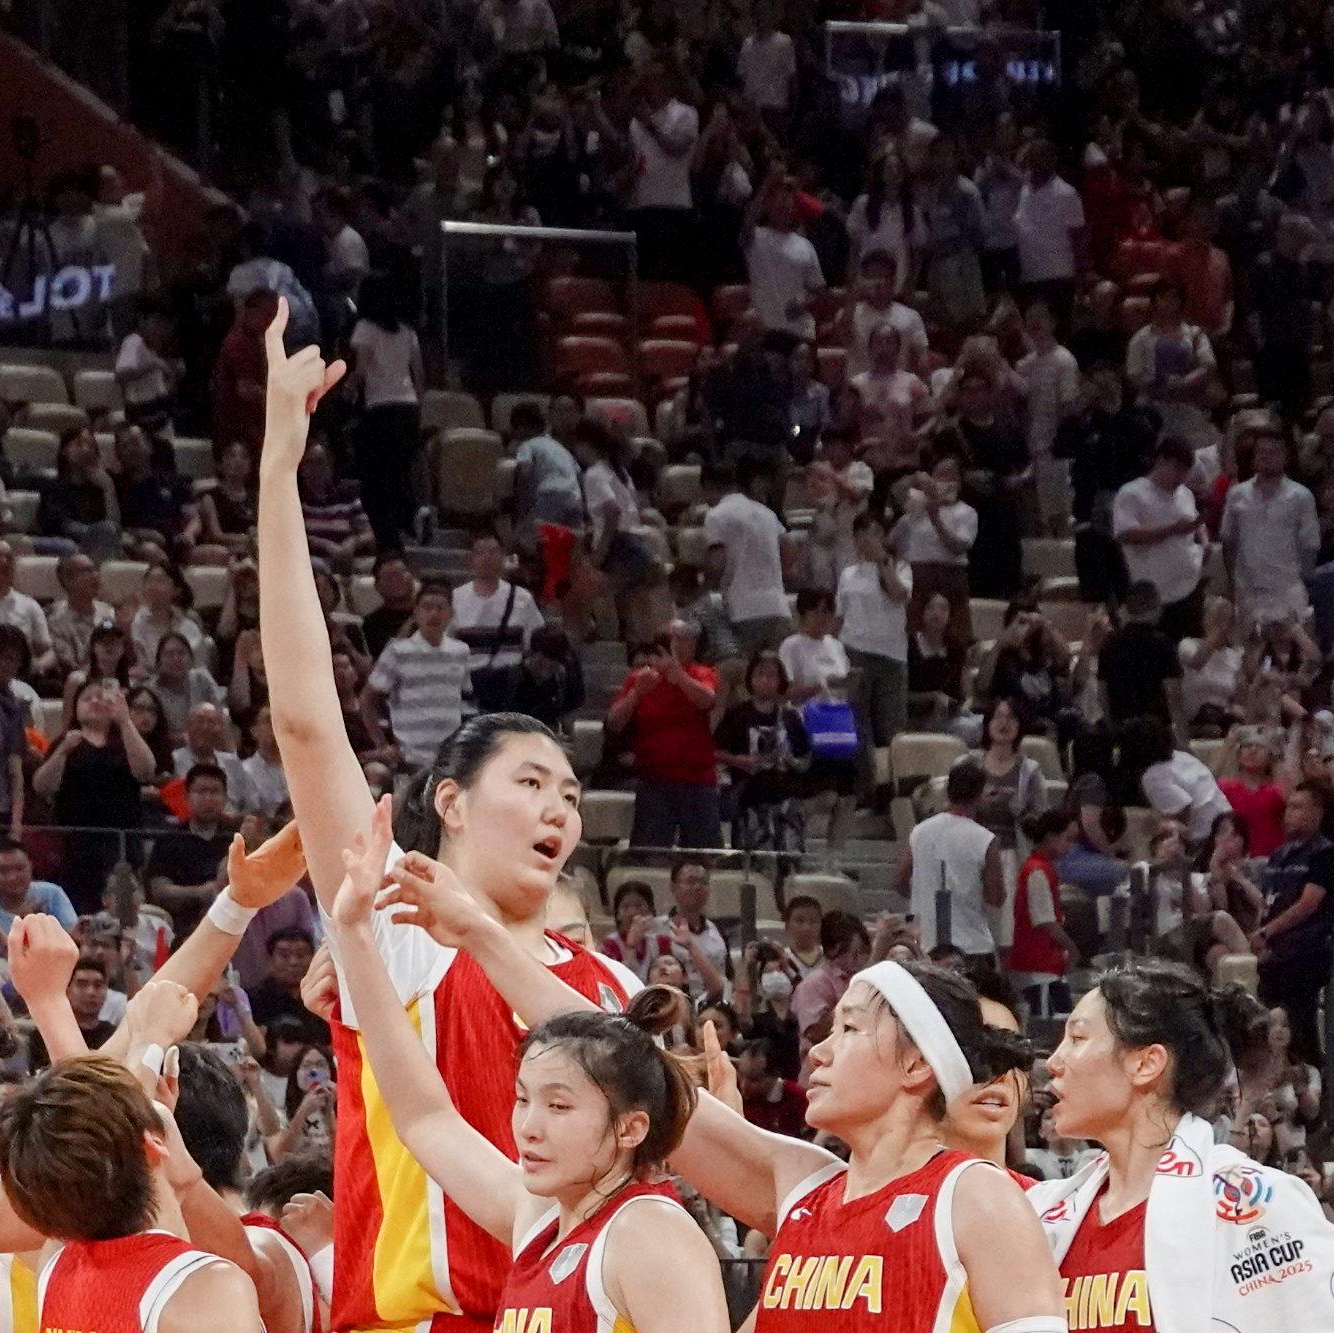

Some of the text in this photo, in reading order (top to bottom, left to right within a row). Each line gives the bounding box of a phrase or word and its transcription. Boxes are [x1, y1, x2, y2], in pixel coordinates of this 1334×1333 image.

[1233, 1232, 1292, 1260] WOMEN'S
[1249, 1231, 1267, 1242] FIBA
[1230, 1239, 1305, 1284] ASIA CUP
[1239, 1260, 1313, 1297] CHINA 2025
[763, 1253, 884, 1314] CHINA
[1060, 1270, 1152, 1330] HINA
